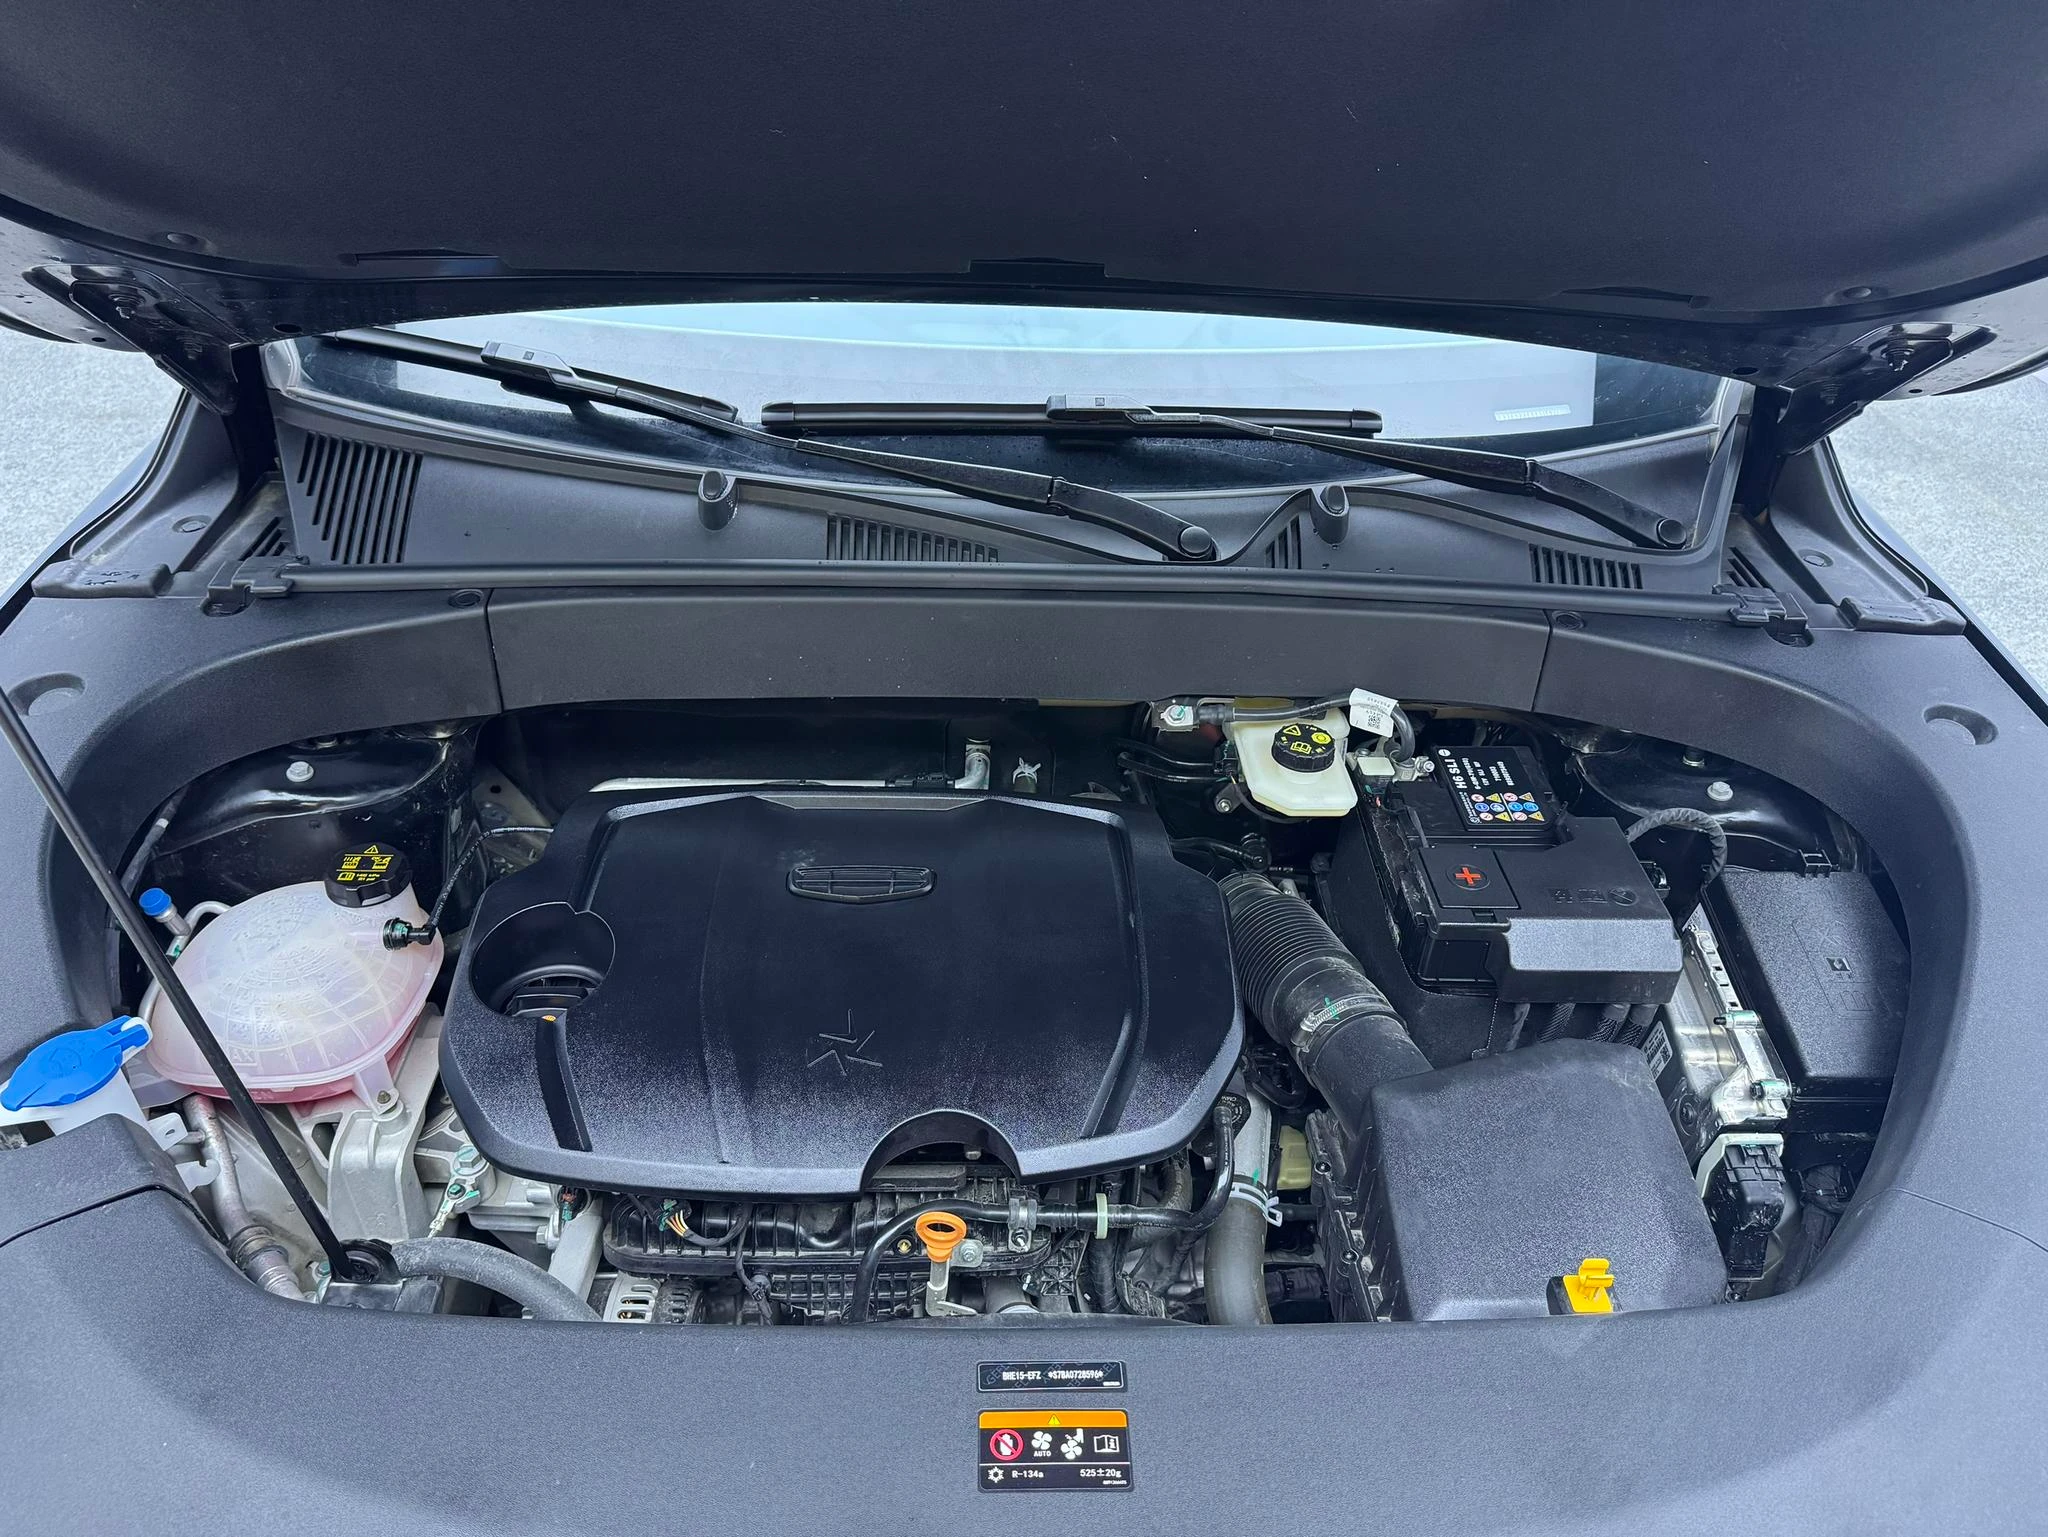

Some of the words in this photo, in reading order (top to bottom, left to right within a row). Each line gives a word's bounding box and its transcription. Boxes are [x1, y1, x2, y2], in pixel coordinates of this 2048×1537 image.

[1444, 758, 1461, 774] SLI
[1452, 775, 1468, 789] H6
[1002, 1371, 1042, 1381] BHE15-EFZ
[1033, 1450, 1052, 1458] AUTO
[1012, 1469, 1044, 1478] R-134a
[1079, 1467, 1122, 1478] 525±20g
